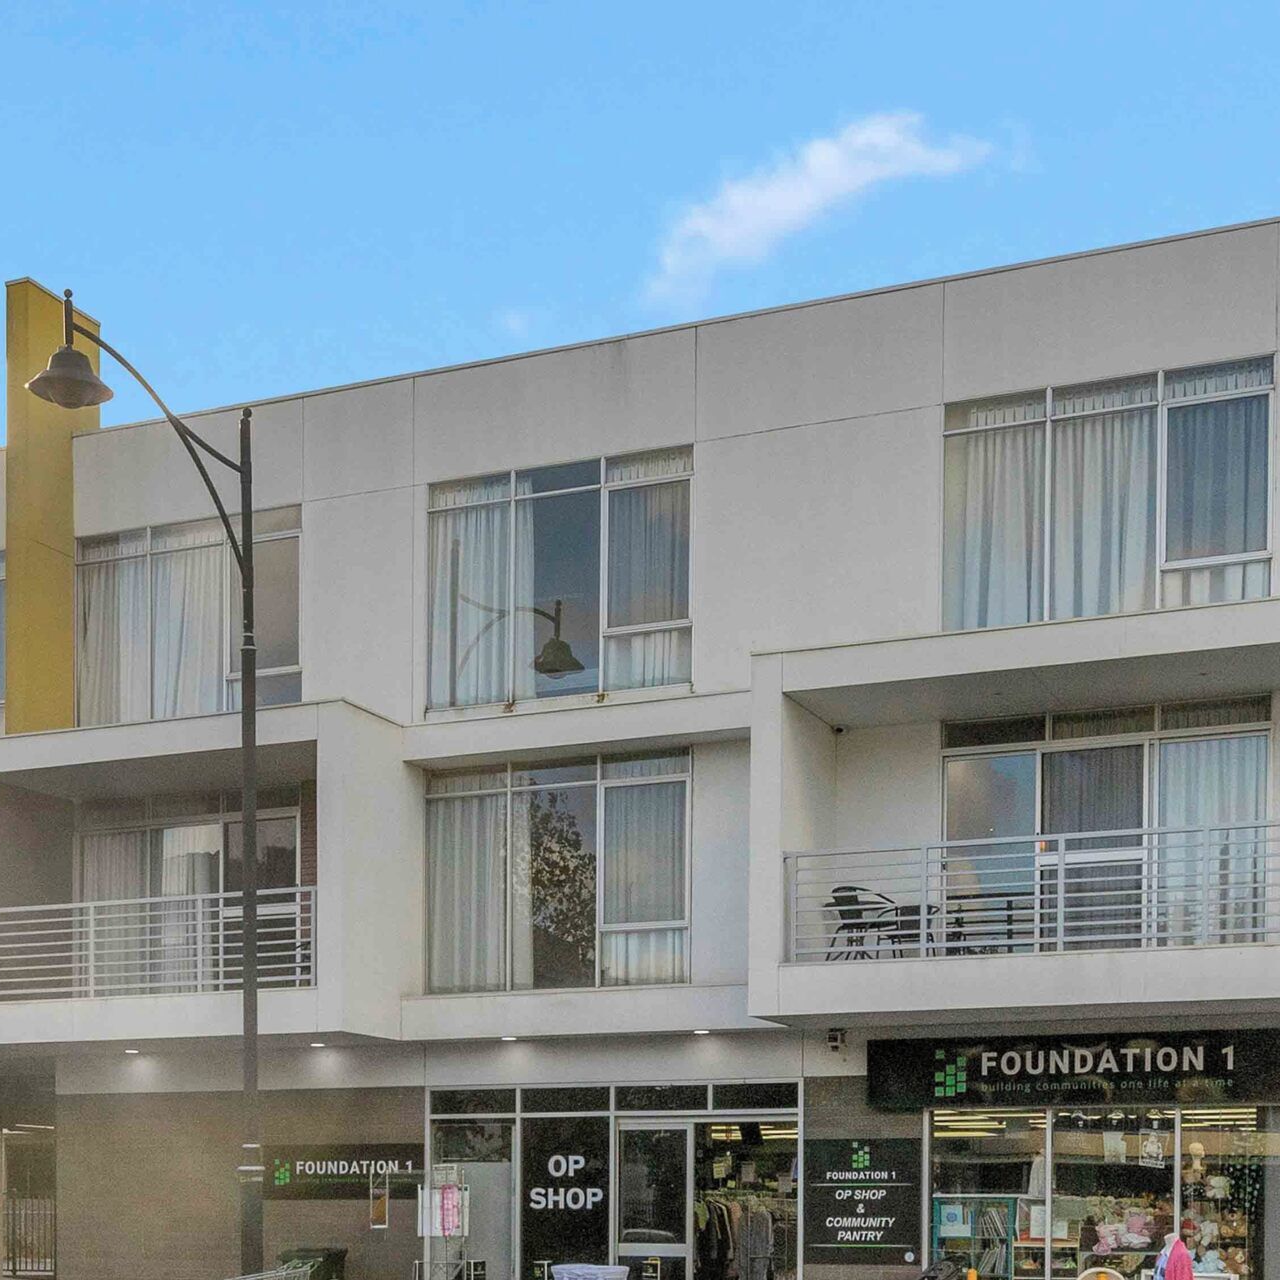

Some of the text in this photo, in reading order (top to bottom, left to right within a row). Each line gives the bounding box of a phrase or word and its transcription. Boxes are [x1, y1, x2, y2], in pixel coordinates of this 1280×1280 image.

[981, 1045, 1235, 1076] FOUNDATION 1
[981, 1081, 1031, 1093] building
[1035, 1080, 1116, 1092] communities
[1120, 1080, 1143, 1089] one
[1148, 1078, 1169, 1088] life
[1204, 1076, 1234, 1088] time
[296, 1160, 413, 1175] FOUNDATION 1
[547, 1154, 586, 1177] OP
[826, 1171, 896, 1180] FOUNDATION 1
[528, 1187, 604, 1210] SHOP
[835, 1189, 887, 1200] OP SHOP
[856, 1203, 865, 1213] &
[825, 1217, 896, 1228] COMMUNITY
[837, 1231, 884, 1241] PANTRY
